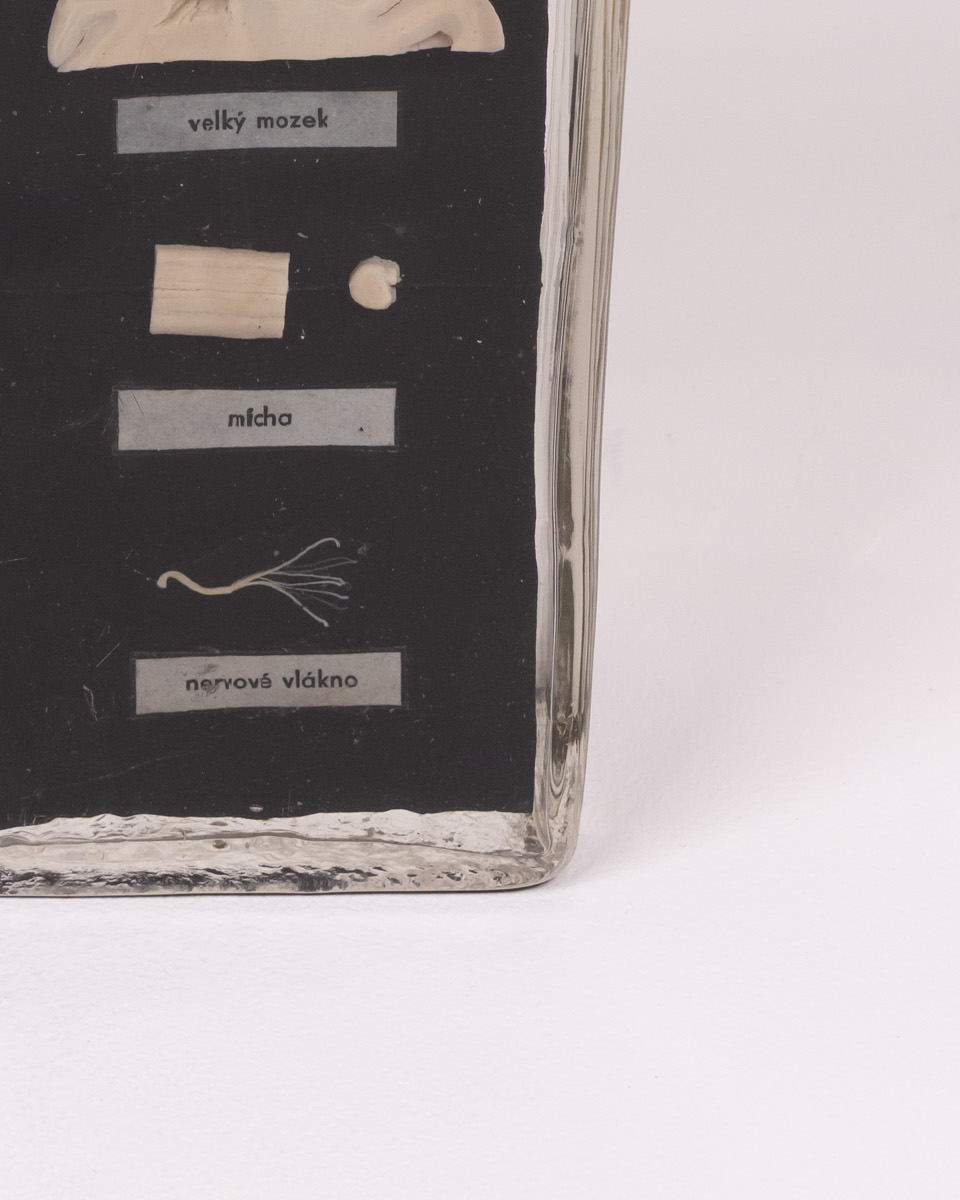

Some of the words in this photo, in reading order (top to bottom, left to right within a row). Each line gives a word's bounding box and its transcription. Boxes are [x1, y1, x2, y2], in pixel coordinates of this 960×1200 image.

[188, 109, 247, 136] velký
[256, 107, 328, 129] mozek
[227, 405, 292, 428] mícha
[281, 668, 359, 689] vlákno
